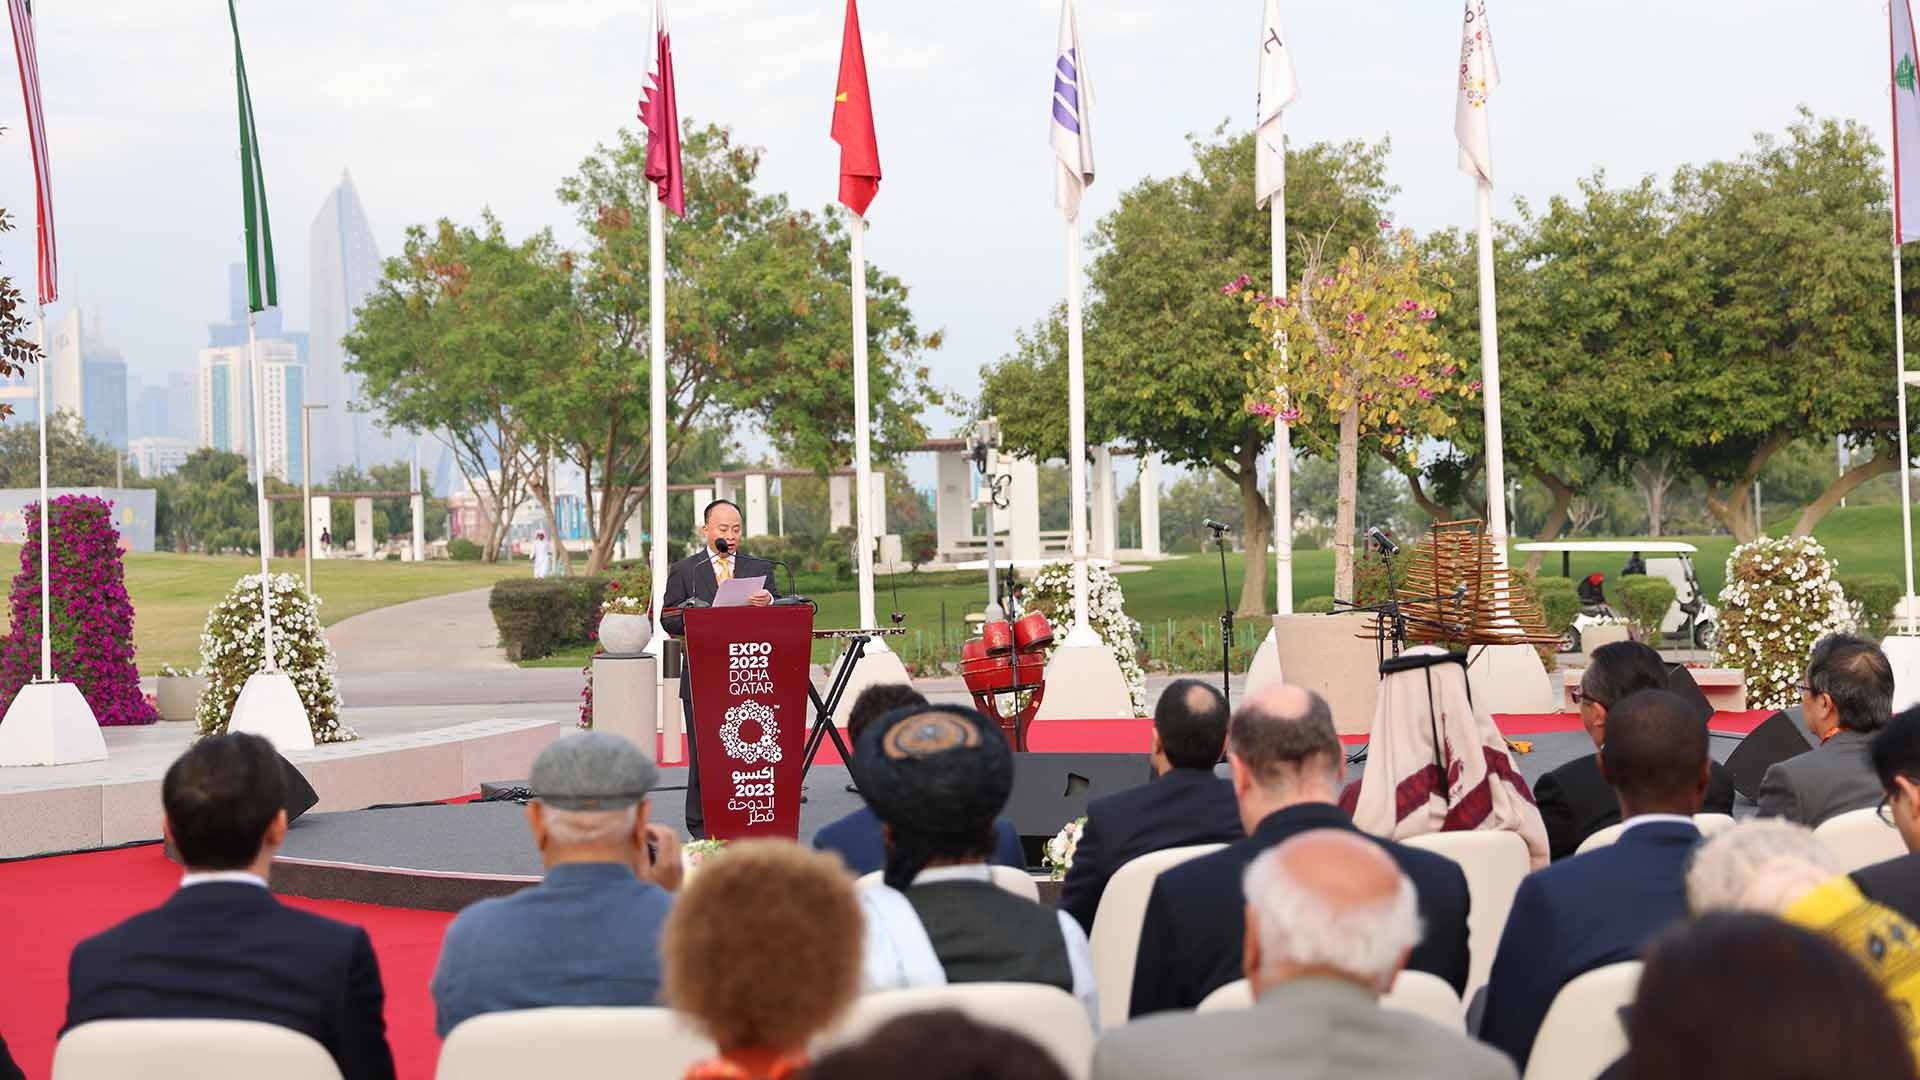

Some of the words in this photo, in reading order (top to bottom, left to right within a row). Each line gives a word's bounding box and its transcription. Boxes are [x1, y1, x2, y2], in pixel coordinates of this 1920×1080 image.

[728, 642, 772, 655] EXPO
[729, 656, 769, 669] 2023
[729, 669, 770, 682] DOHA
[728, 682, 774, 695] QATAR
[731, 766, 775, 784] إكسبو
[735, 784, 775, 797] 2023
[727, 797, 775, 813] الدوحة
[746, 810, 775, 826] قطر
